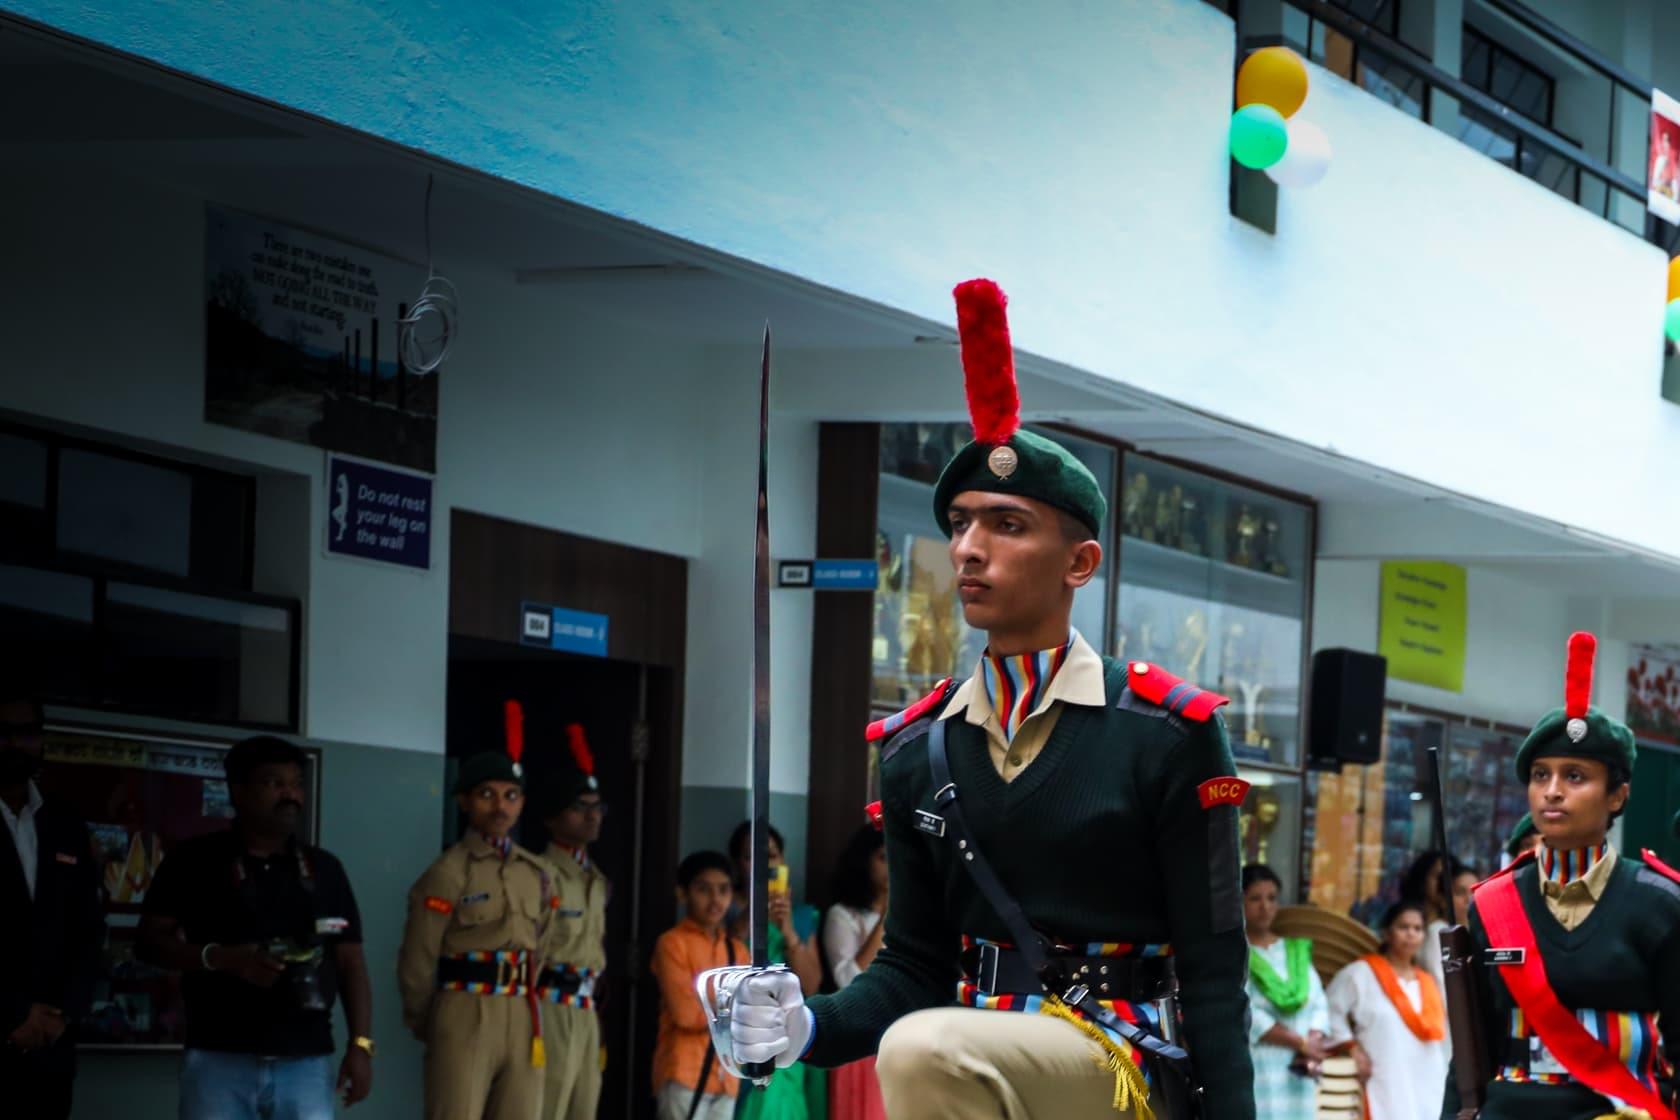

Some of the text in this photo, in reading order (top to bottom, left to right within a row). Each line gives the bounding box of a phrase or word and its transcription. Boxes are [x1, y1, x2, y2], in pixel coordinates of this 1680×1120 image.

[357, 483, 426, 512] Do not rest
[356, 509, 427, 534] your leg on
[356, 528, 405, 551] the wall
[1208, 783, 1241, 801] NCC
